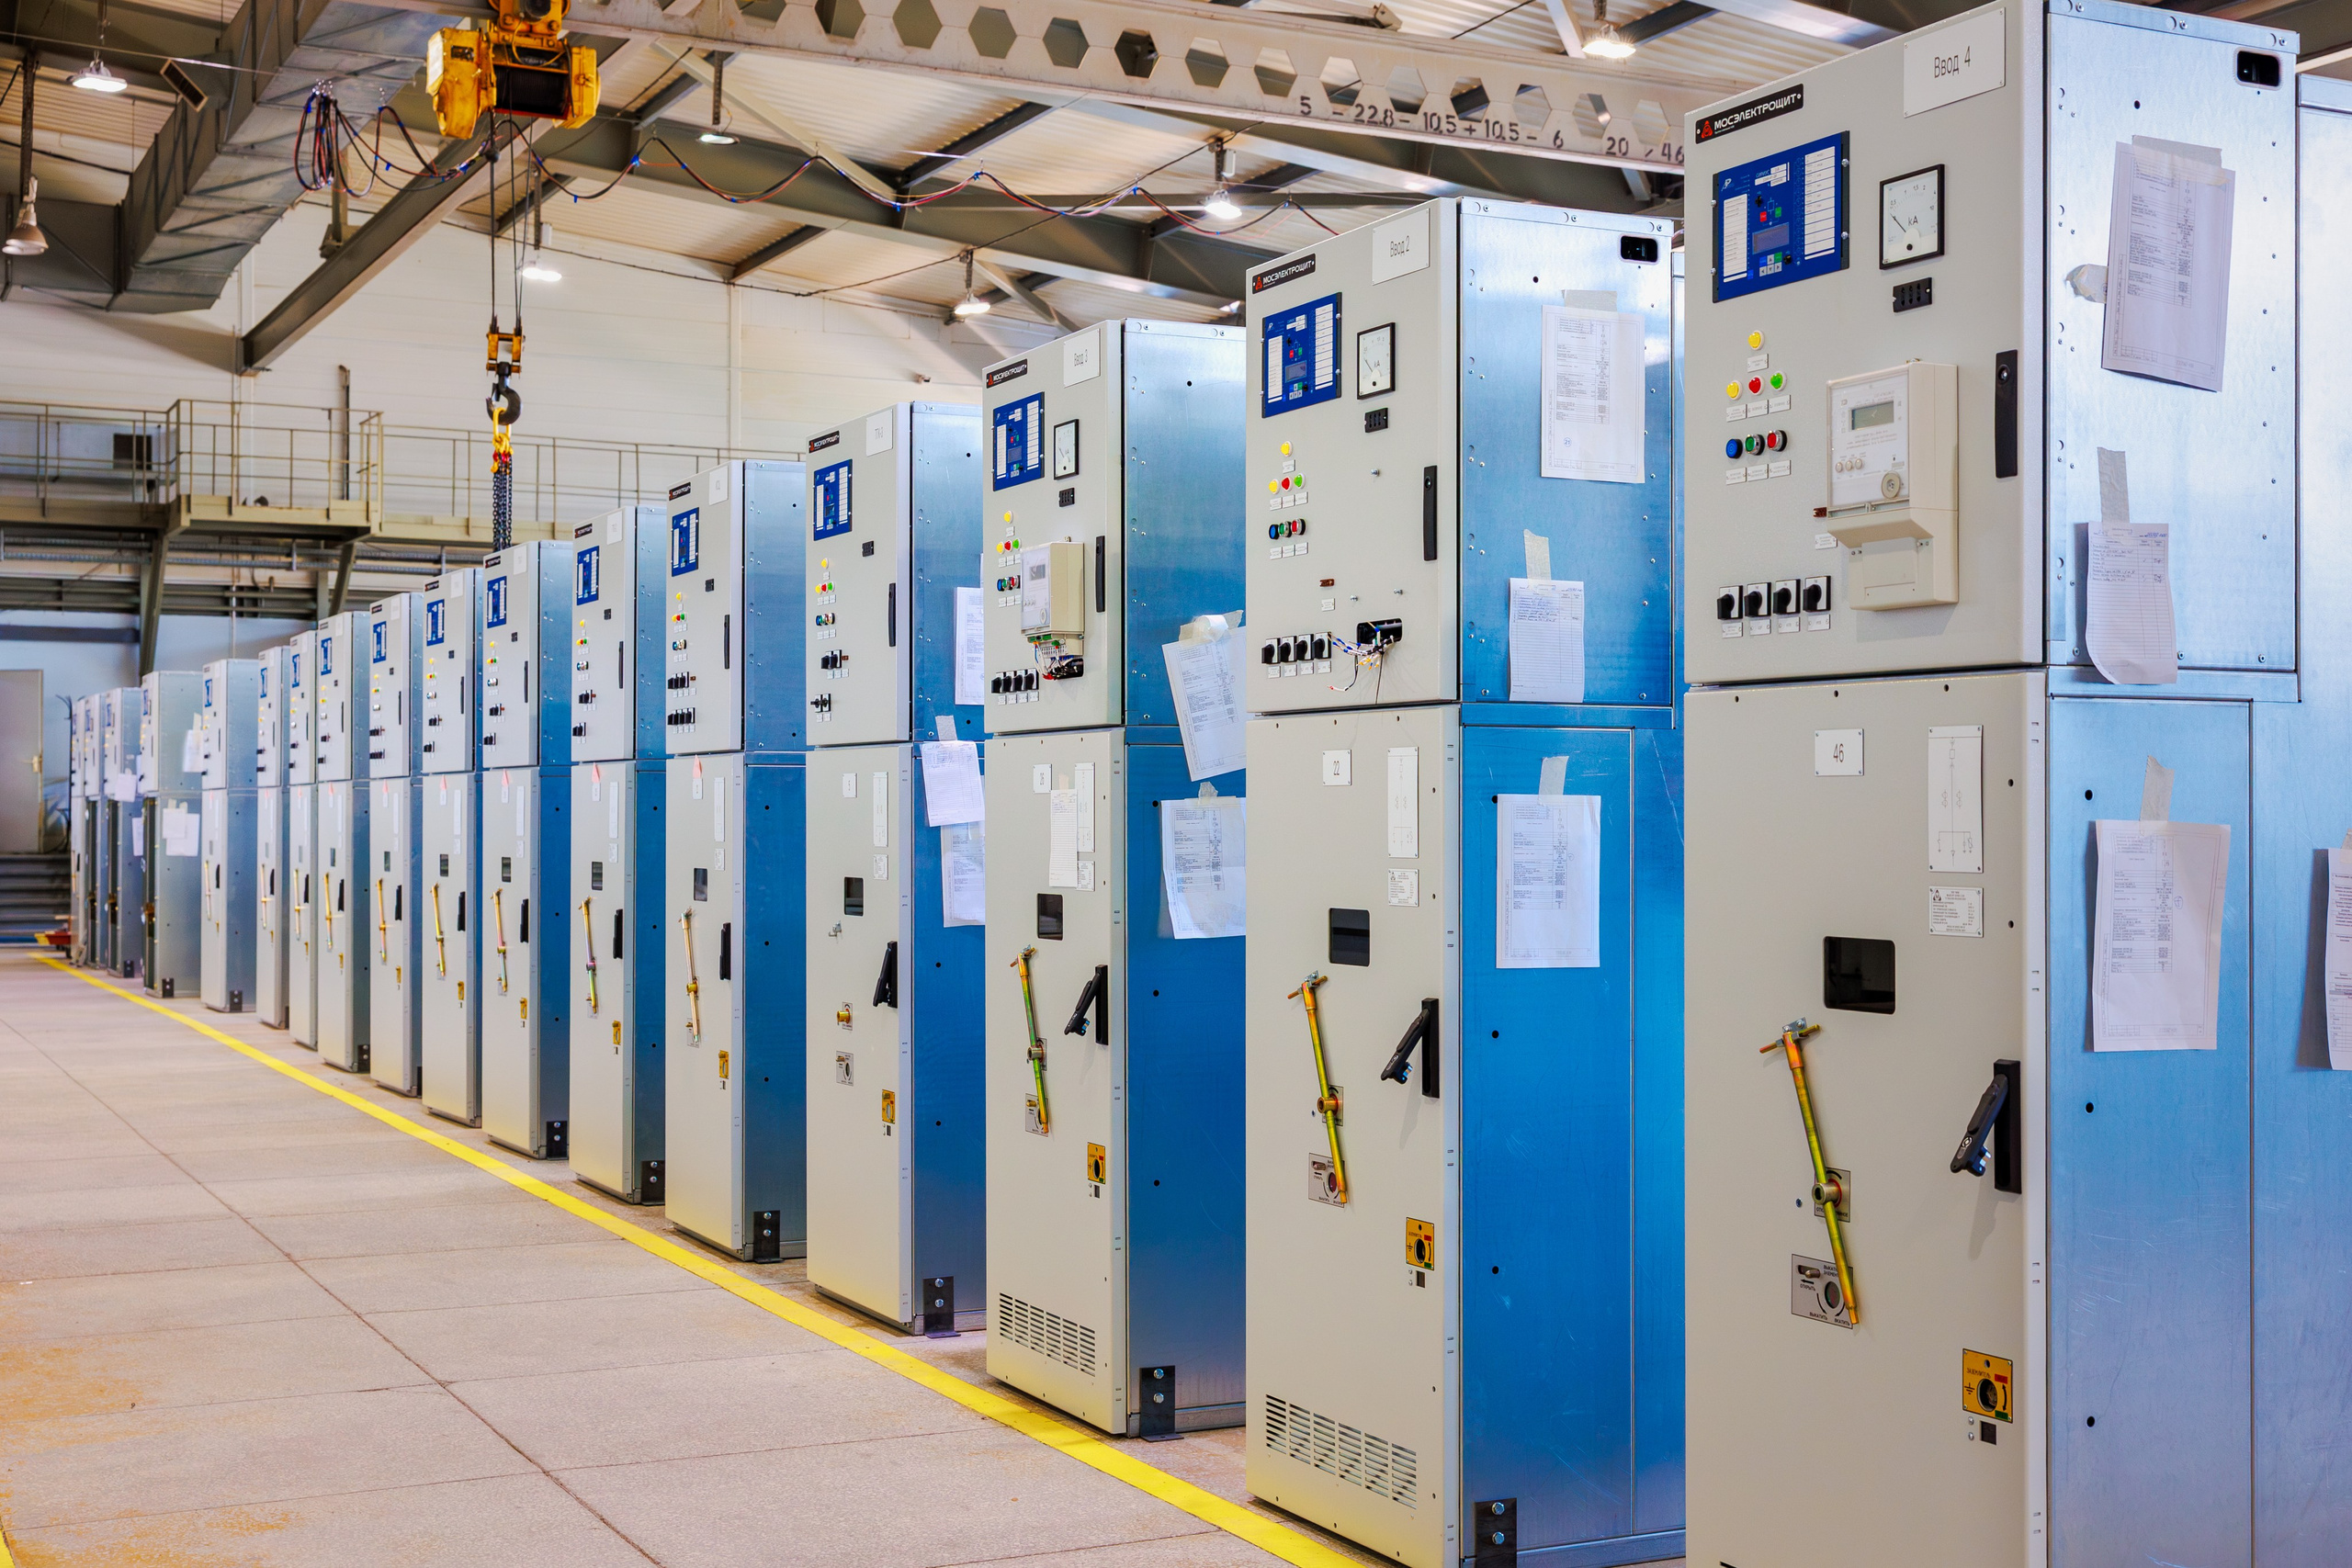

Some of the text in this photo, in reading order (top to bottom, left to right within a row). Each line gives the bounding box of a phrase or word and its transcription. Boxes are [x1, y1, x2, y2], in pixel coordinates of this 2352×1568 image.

[1934, 45, 1971, 78] Ввод 4
[1713, 93, 1797, 130] МОСЭЛЕКТРОЩИТ
[1300, 96, 1312, 116] 5
[1553, 130, 1564, 149] 6
[1606, 136, 1629, 156] 20
[1389, 234, 1410, 257] Ввод 2
[1262, 260, 1312, 285] МОСЭЛЕКТРОЩИТ
[1833, 743, 1845, 763] 46
[1332, 760, 1340, 776] 22
[1966, 1367, 1992, 1379] ЗАЗЕМЛИТЕЛЬ
